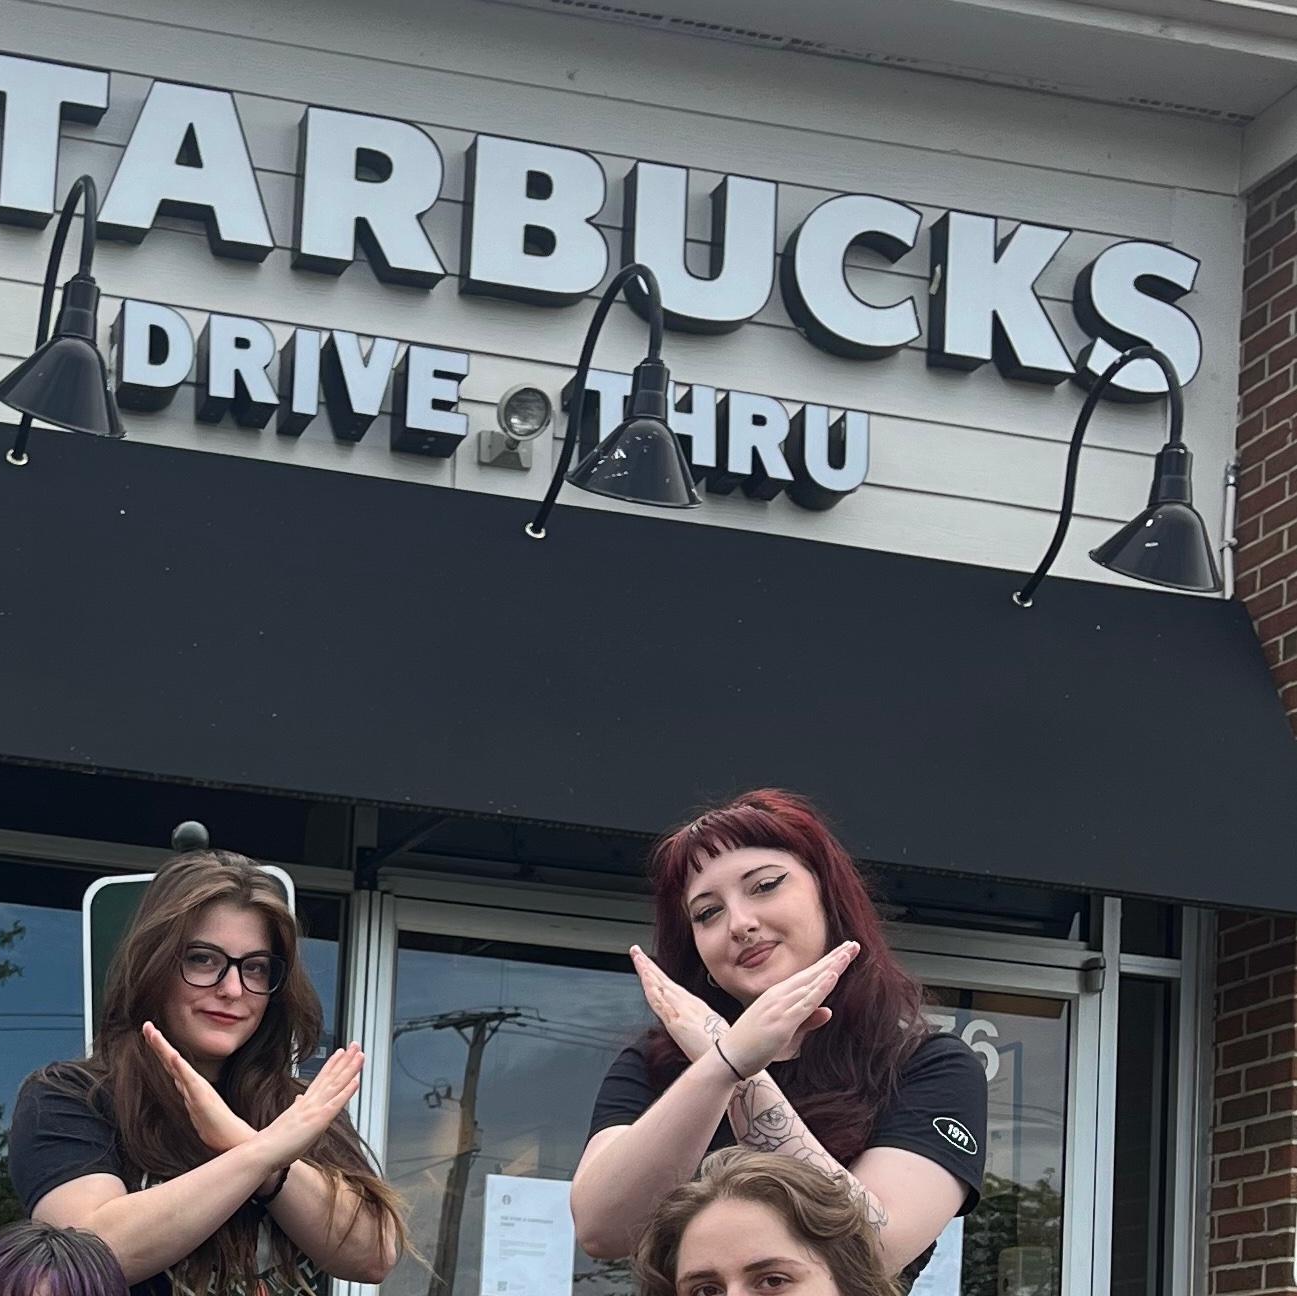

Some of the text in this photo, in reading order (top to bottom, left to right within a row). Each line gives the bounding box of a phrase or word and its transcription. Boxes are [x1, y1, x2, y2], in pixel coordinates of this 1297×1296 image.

[118, 299, 872, 495] DRIVE THRU
[947, 1123, 969, 1147] 1971
